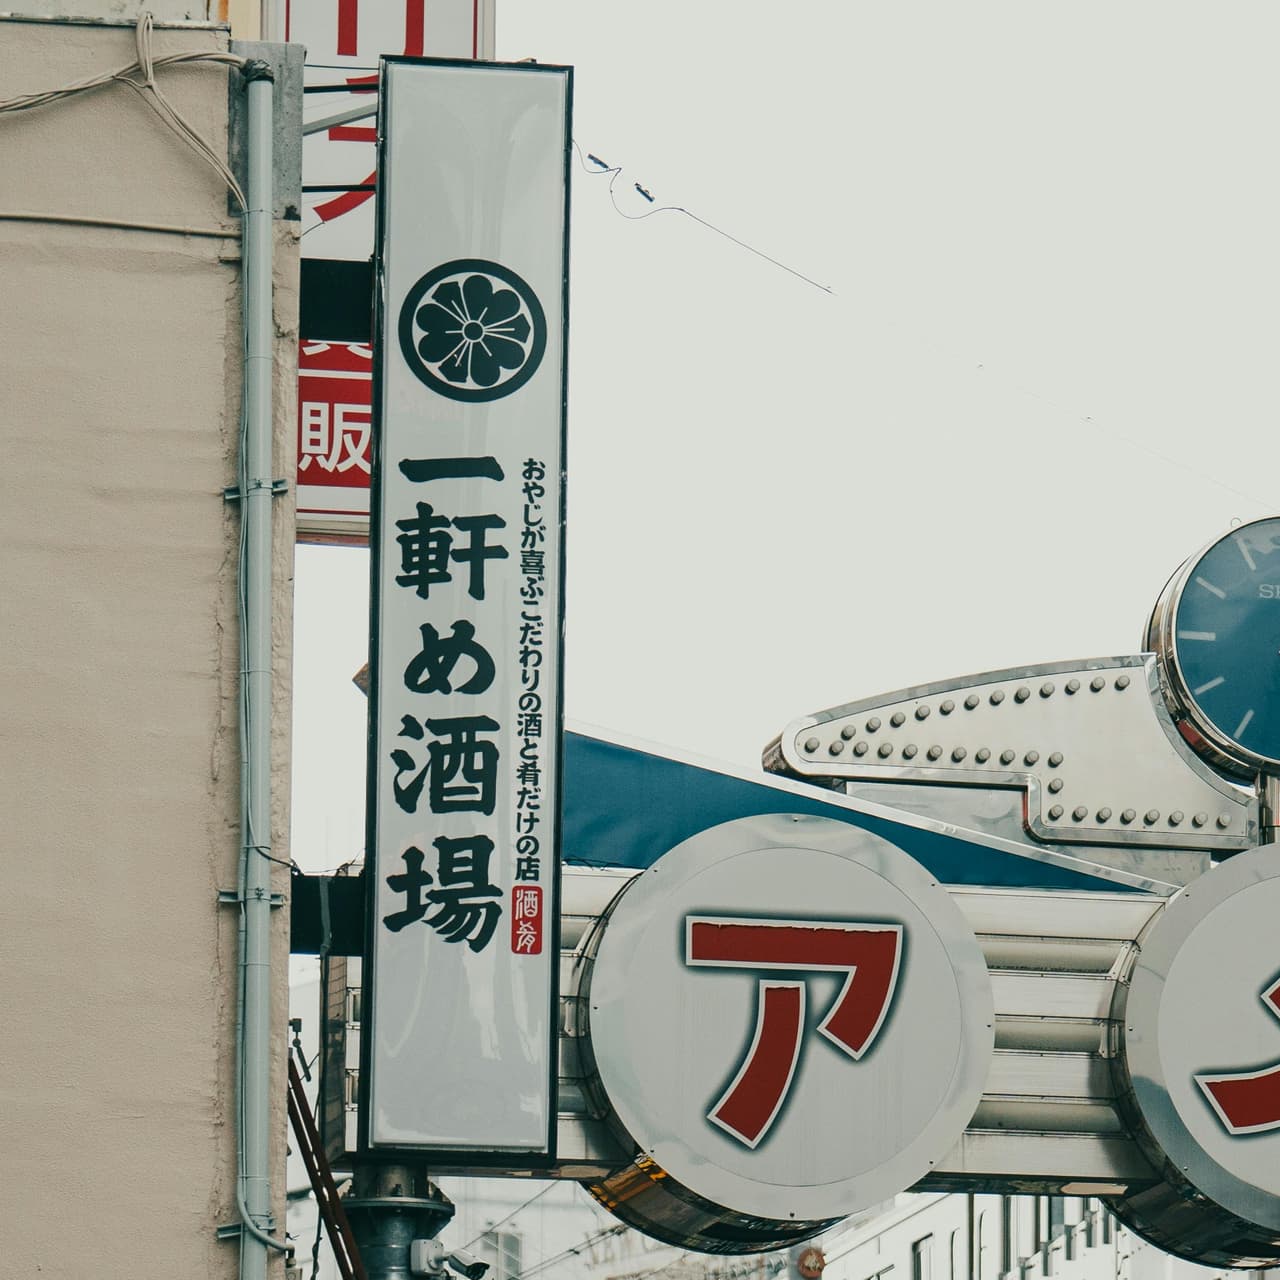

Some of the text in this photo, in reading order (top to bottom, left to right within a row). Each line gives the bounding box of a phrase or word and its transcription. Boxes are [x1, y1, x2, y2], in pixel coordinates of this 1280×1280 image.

[384, 455, 509, 954] 一軒め酒場
[514, 458, 547, 882] おやじが喜ぶこだわりの酒と肴だけの店
